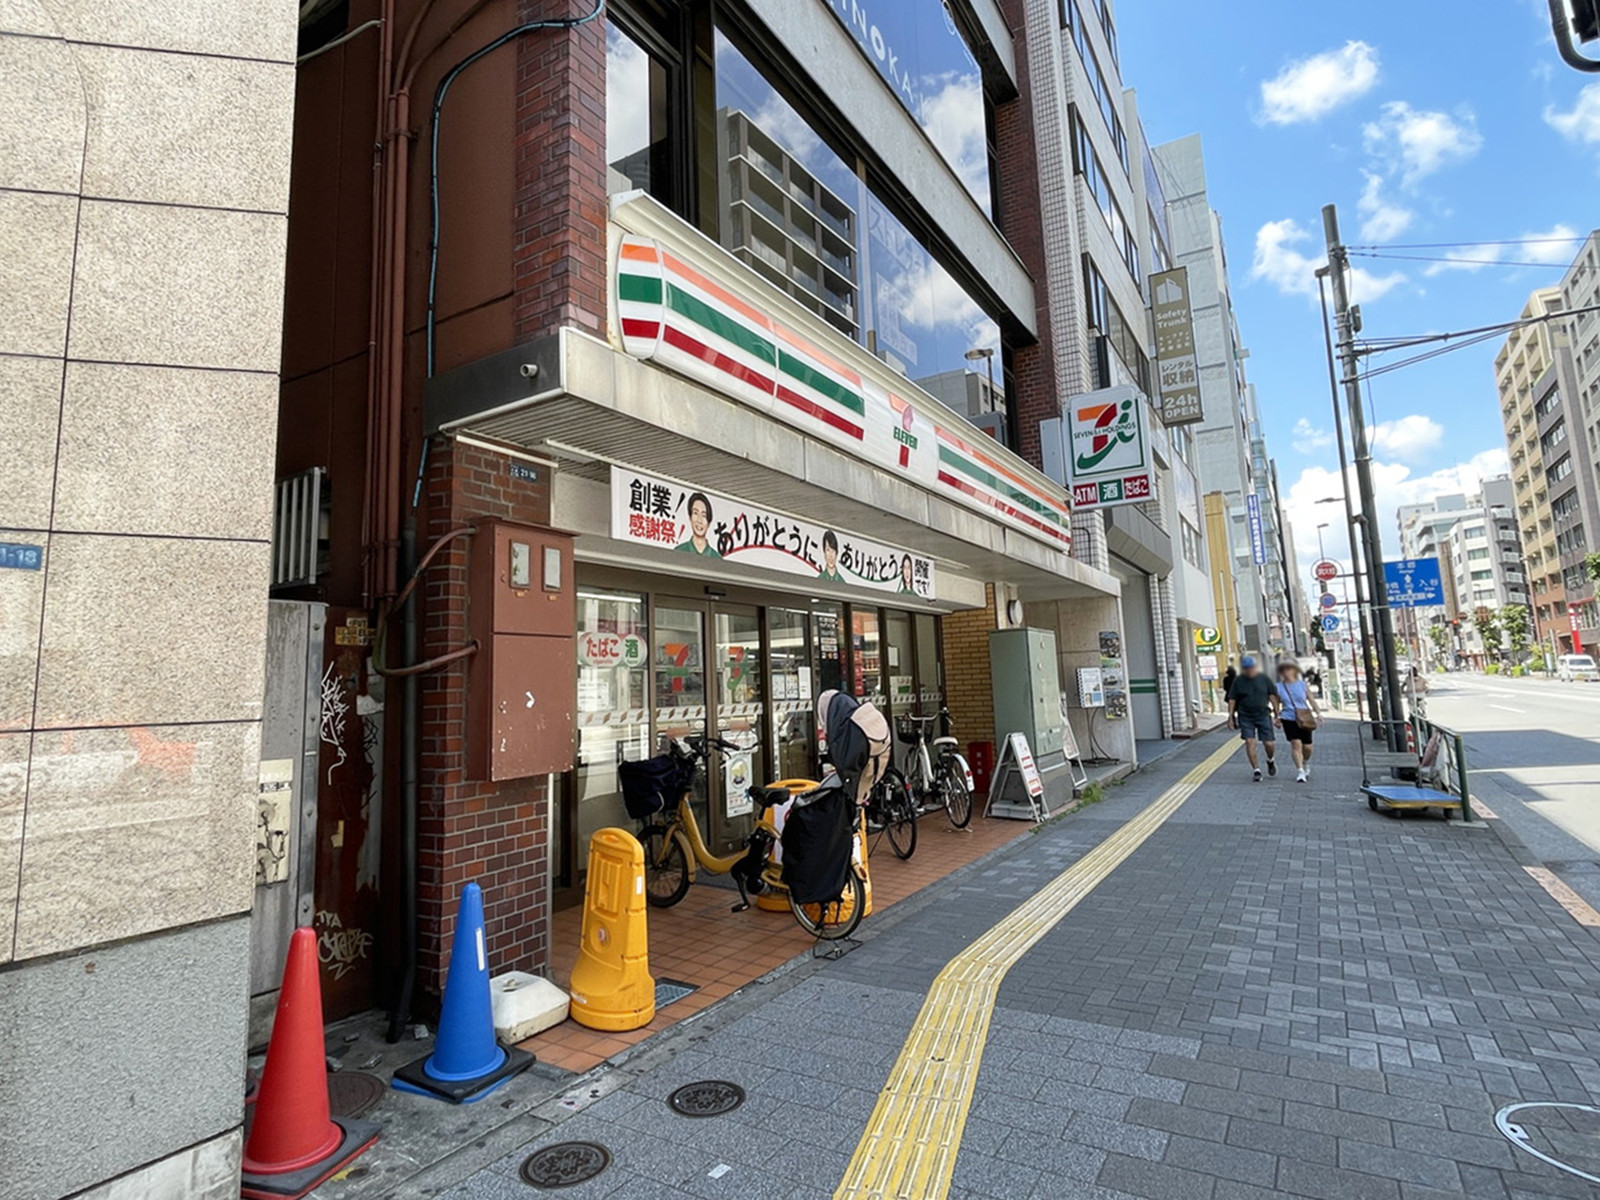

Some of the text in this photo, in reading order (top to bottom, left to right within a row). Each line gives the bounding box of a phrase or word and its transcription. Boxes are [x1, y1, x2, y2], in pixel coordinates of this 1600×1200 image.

[1156, 310, 1187, 321] Safety
[1157, 317, 1188, 329] Trunk
[1162, 360, 1194, 373] レンタル
[1162, 369, 1195, 387] 収納
[1164, 393, 1197, 409] 24h
[1165, 405, 1199, 418] OPEN
[1073, 430, 1093, 440] SEVEN
[1102, 422, 1136, 434] HOLDINGS
[1075, 478, 1149, 504] ATM 酒 たばこ
[1204, 627, 1216, 642] P
[586, 637, 639, 658] たばこ 酒
